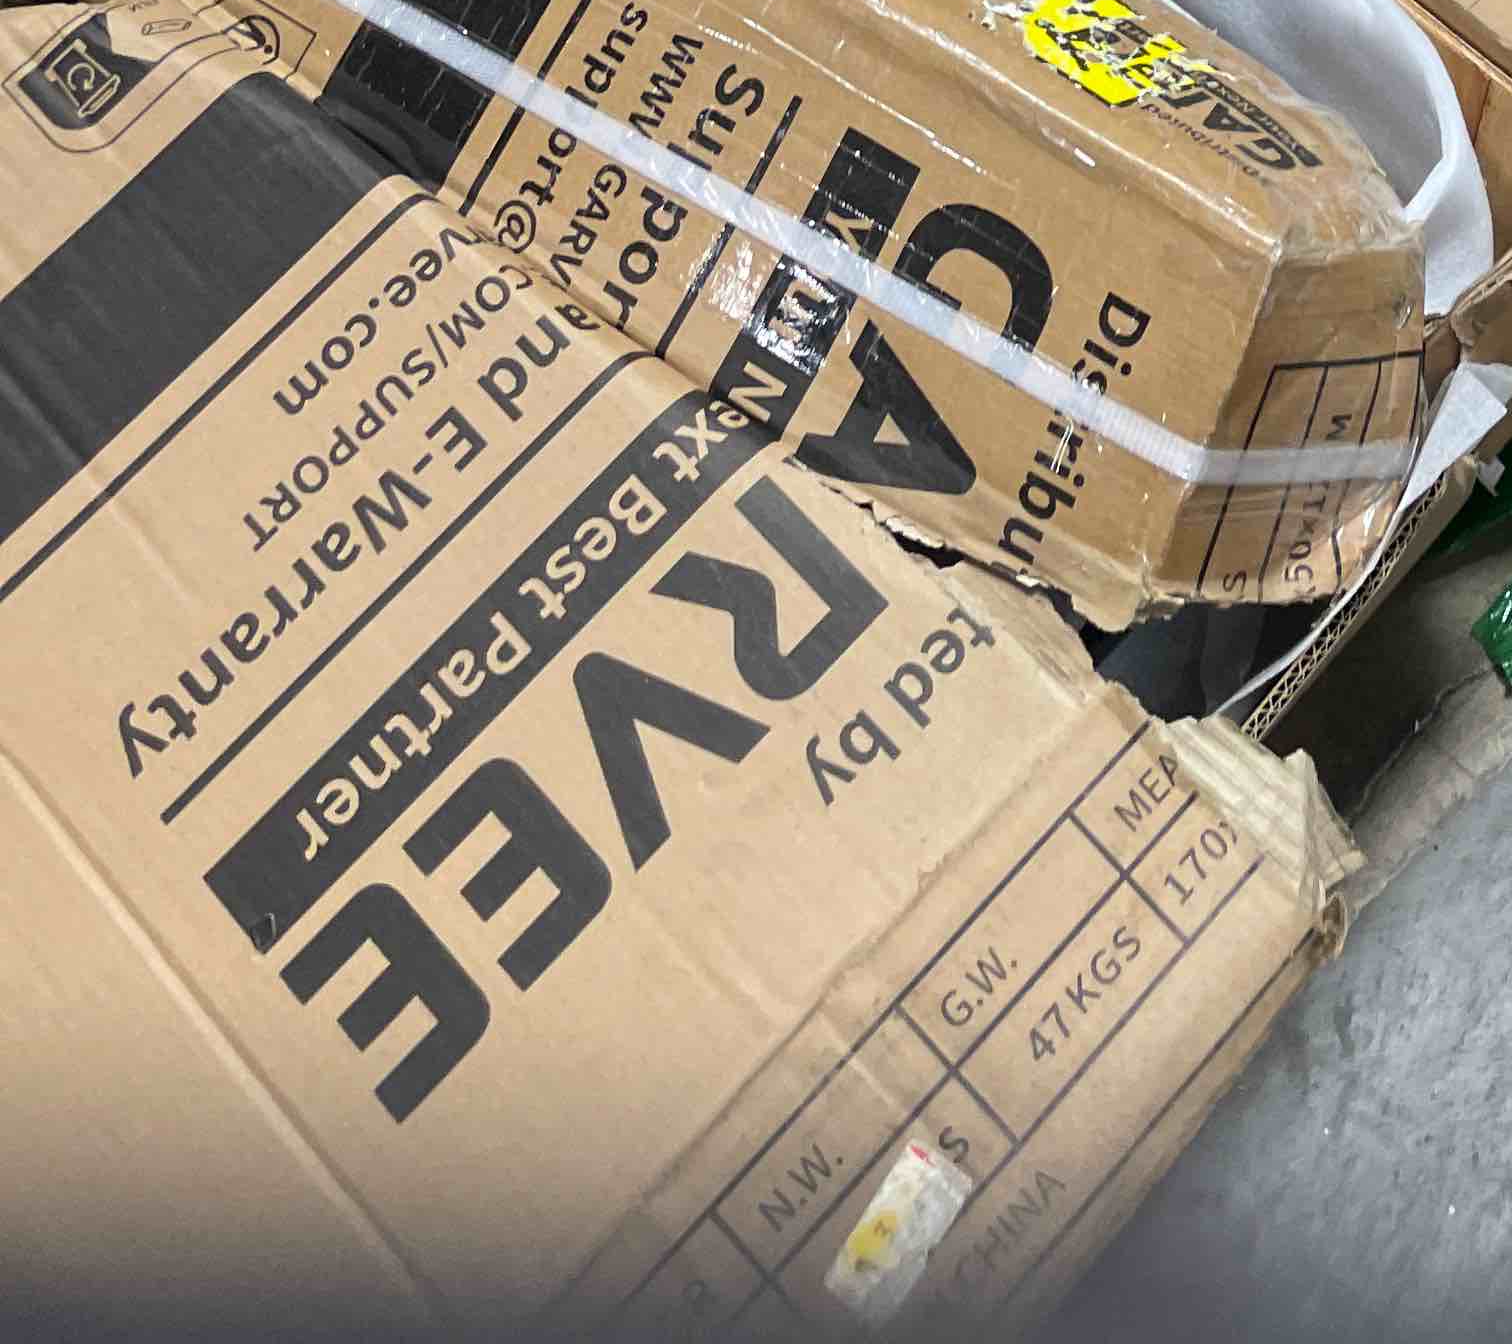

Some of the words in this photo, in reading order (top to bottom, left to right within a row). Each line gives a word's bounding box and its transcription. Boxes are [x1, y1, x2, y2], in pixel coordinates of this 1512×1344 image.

[118, 405, 489, 780] E-Warranty
[518, 473, 669, 620] Best
[296, 610, 533, 861] Partner
[806, 712, 901, 806] by
[1113, 753, 1182, 835] MEA
[940, 943, 1018, 1031] G.W.
[758, 1141, 844, 1233] N.W.
